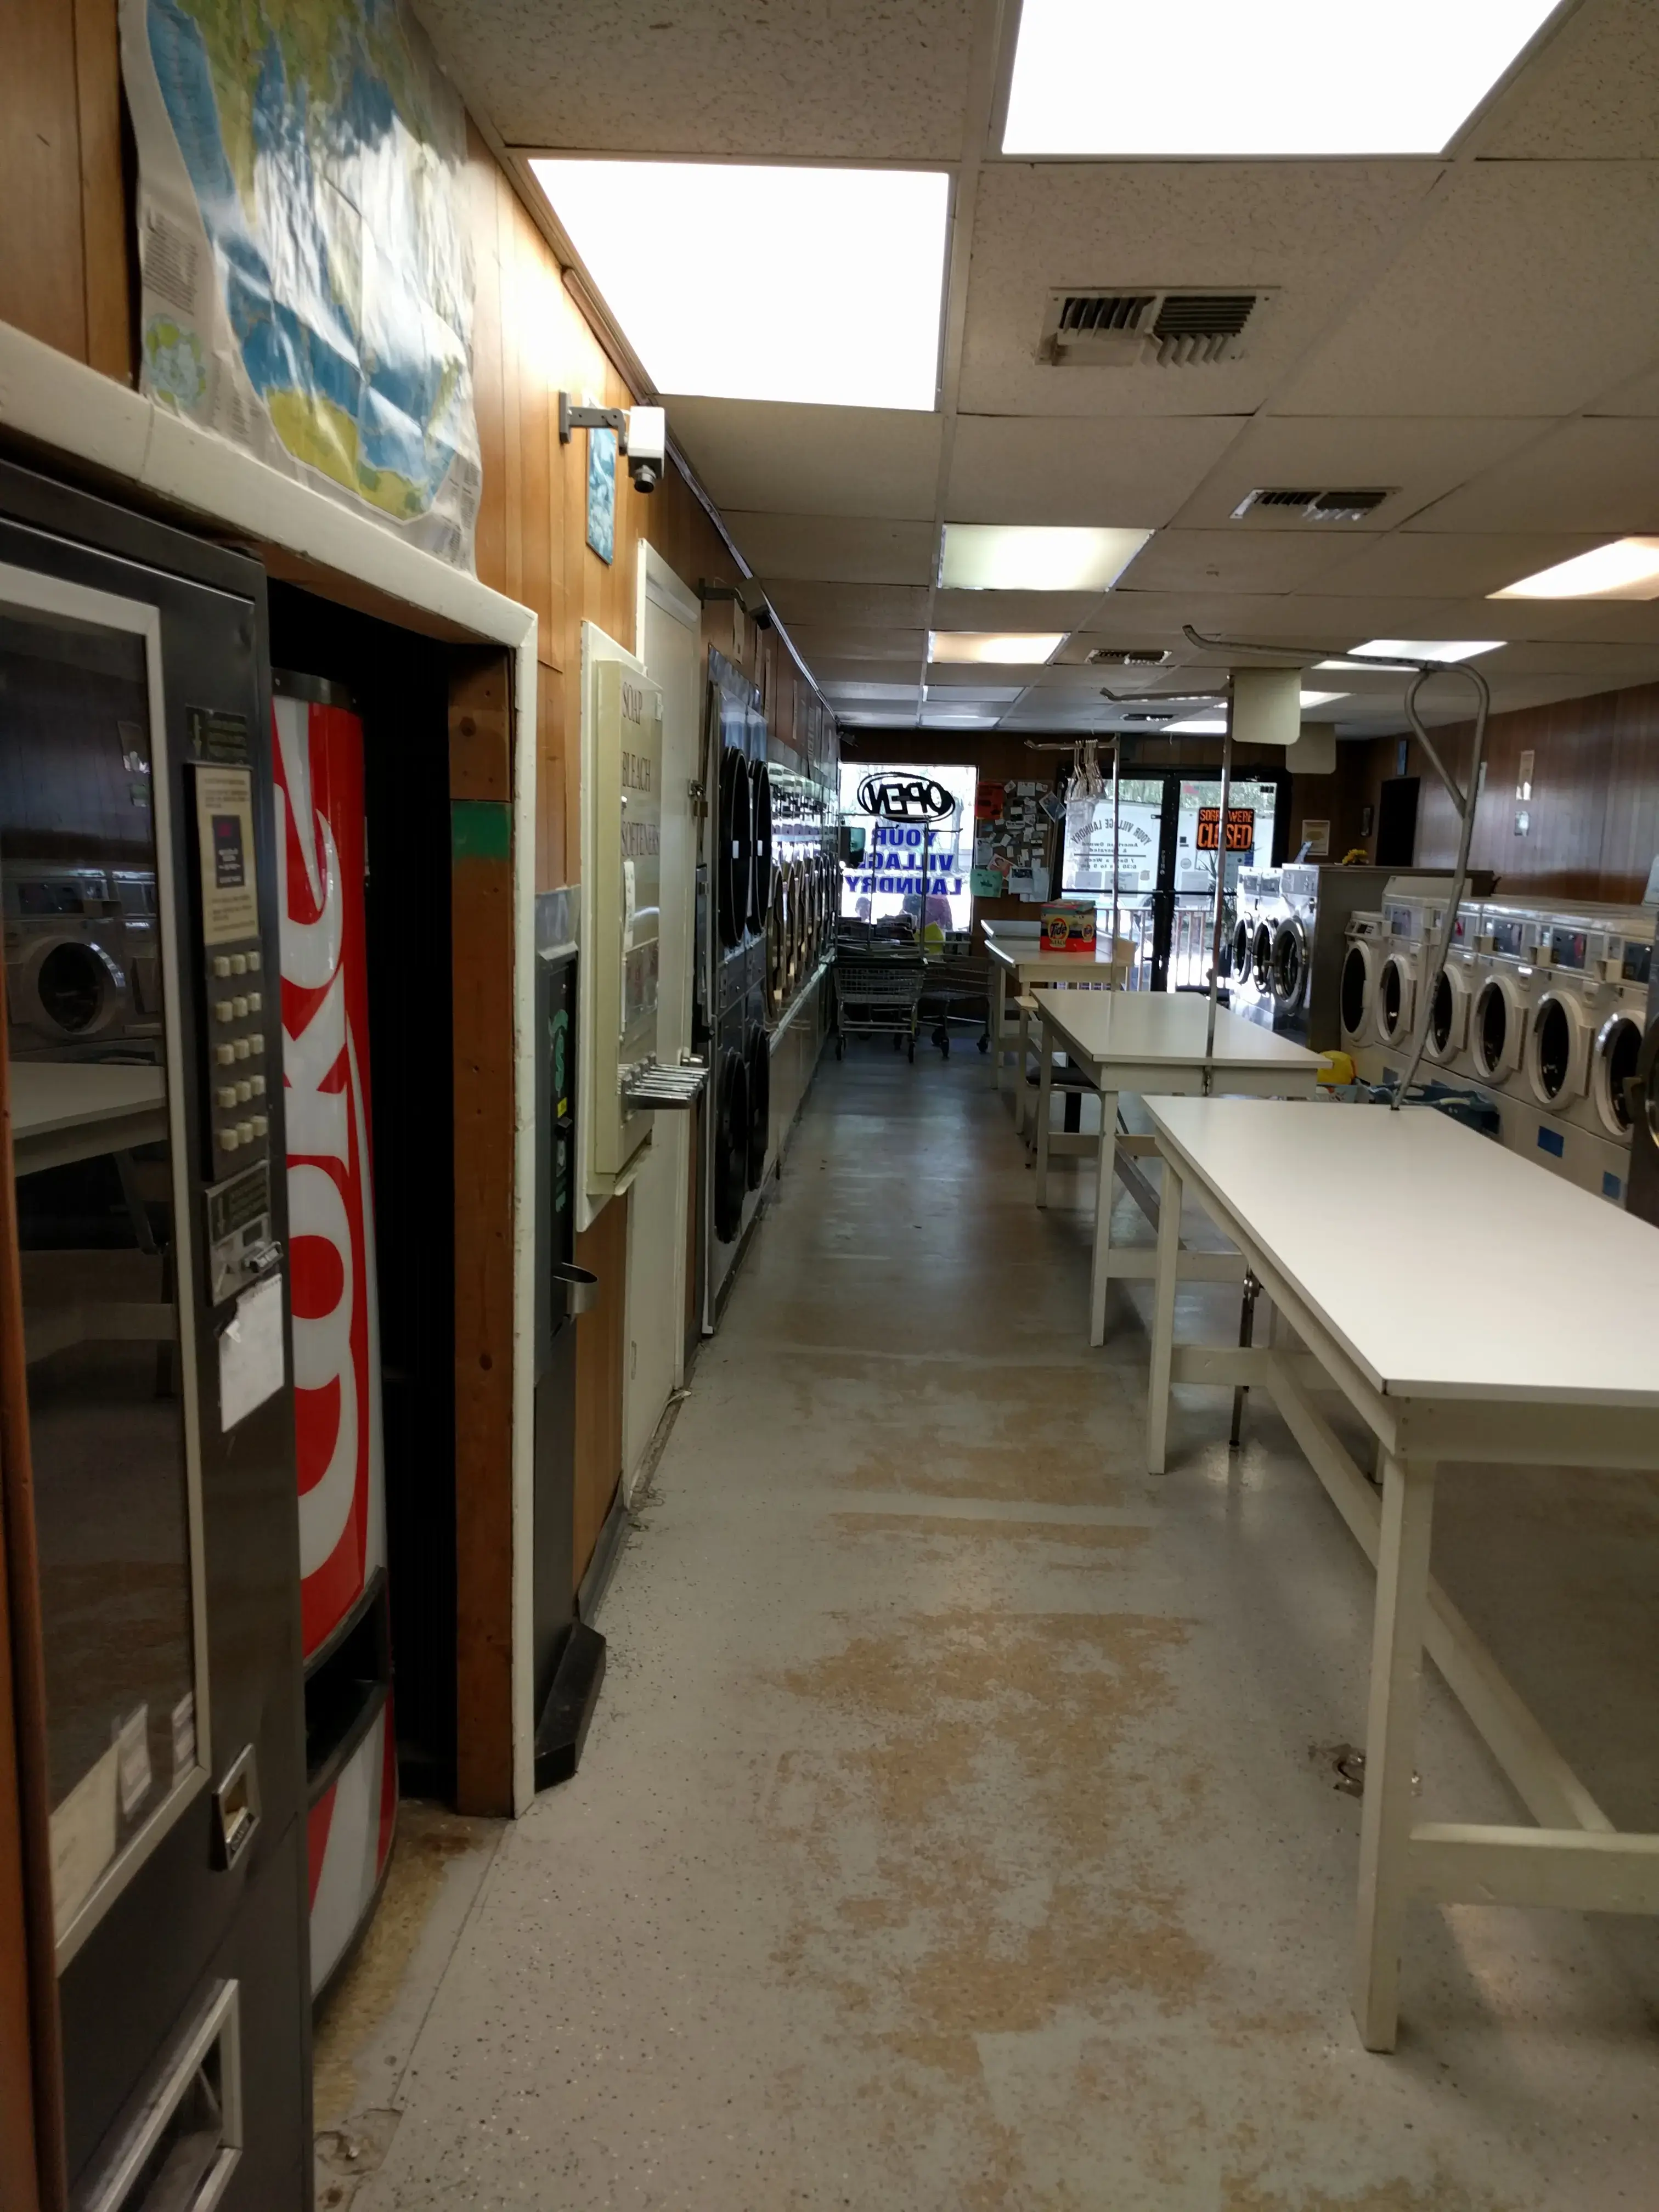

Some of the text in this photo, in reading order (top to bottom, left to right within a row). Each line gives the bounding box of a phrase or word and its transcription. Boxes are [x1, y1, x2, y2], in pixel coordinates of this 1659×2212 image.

[622, 681, 643, 725] SOAP
[622, 751, 651, 792] BLEACH
[1200, 810, 1221, 822] SORR
[1050, 922, 1068, 938] Tide
